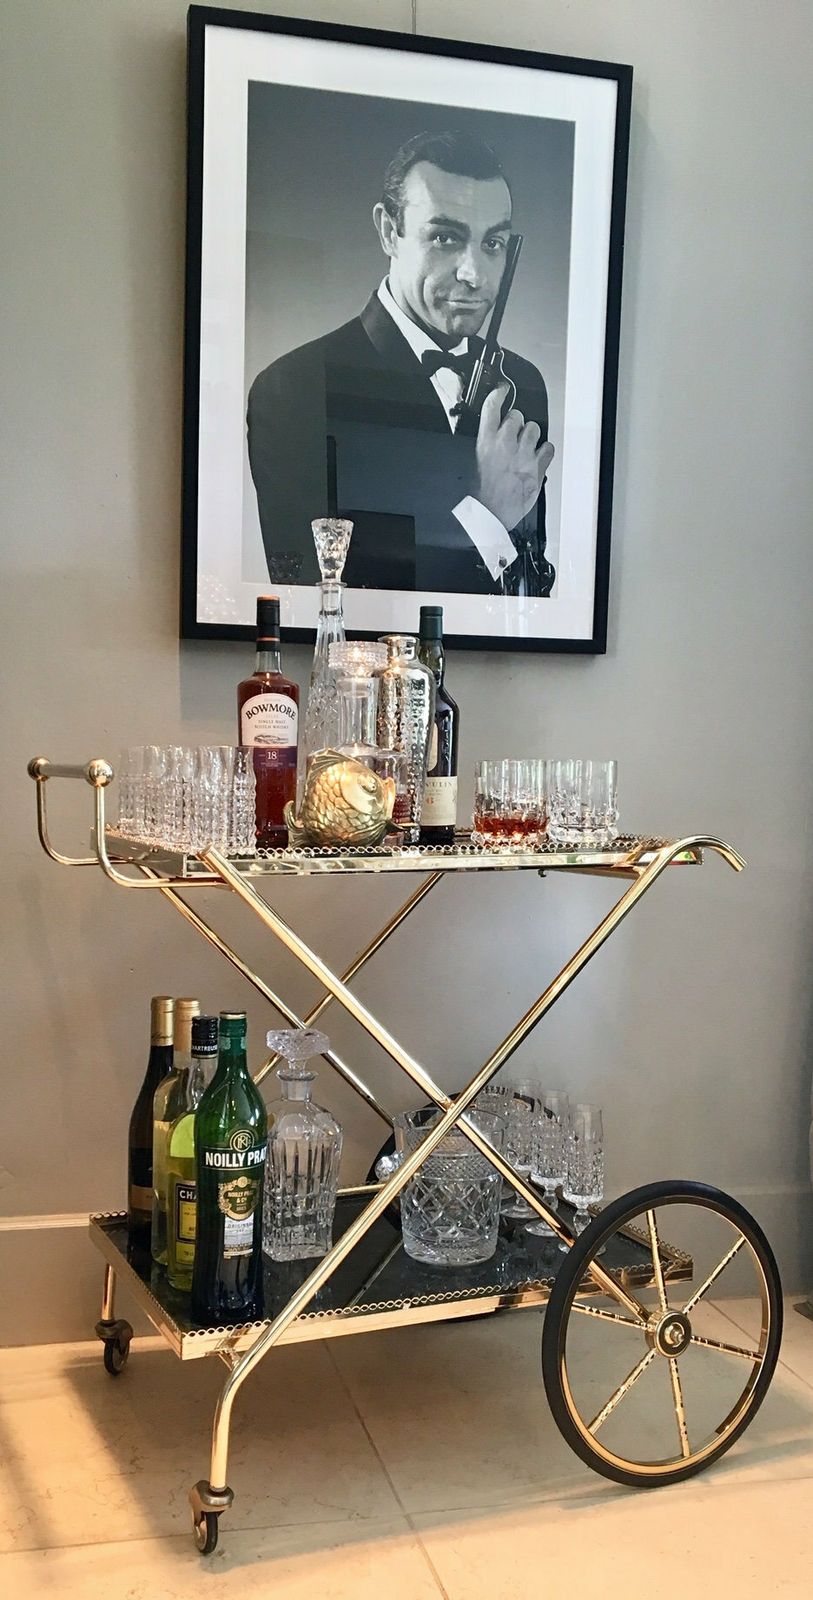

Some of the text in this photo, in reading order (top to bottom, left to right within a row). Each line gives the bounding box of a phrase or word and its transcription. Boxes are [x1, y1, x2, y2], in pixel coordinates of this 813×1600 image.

[245, 703, 297, 721] BOWMORE
[267, 751, 277, 760] 18
[205, 1151, 246, 1168] NOILLY
